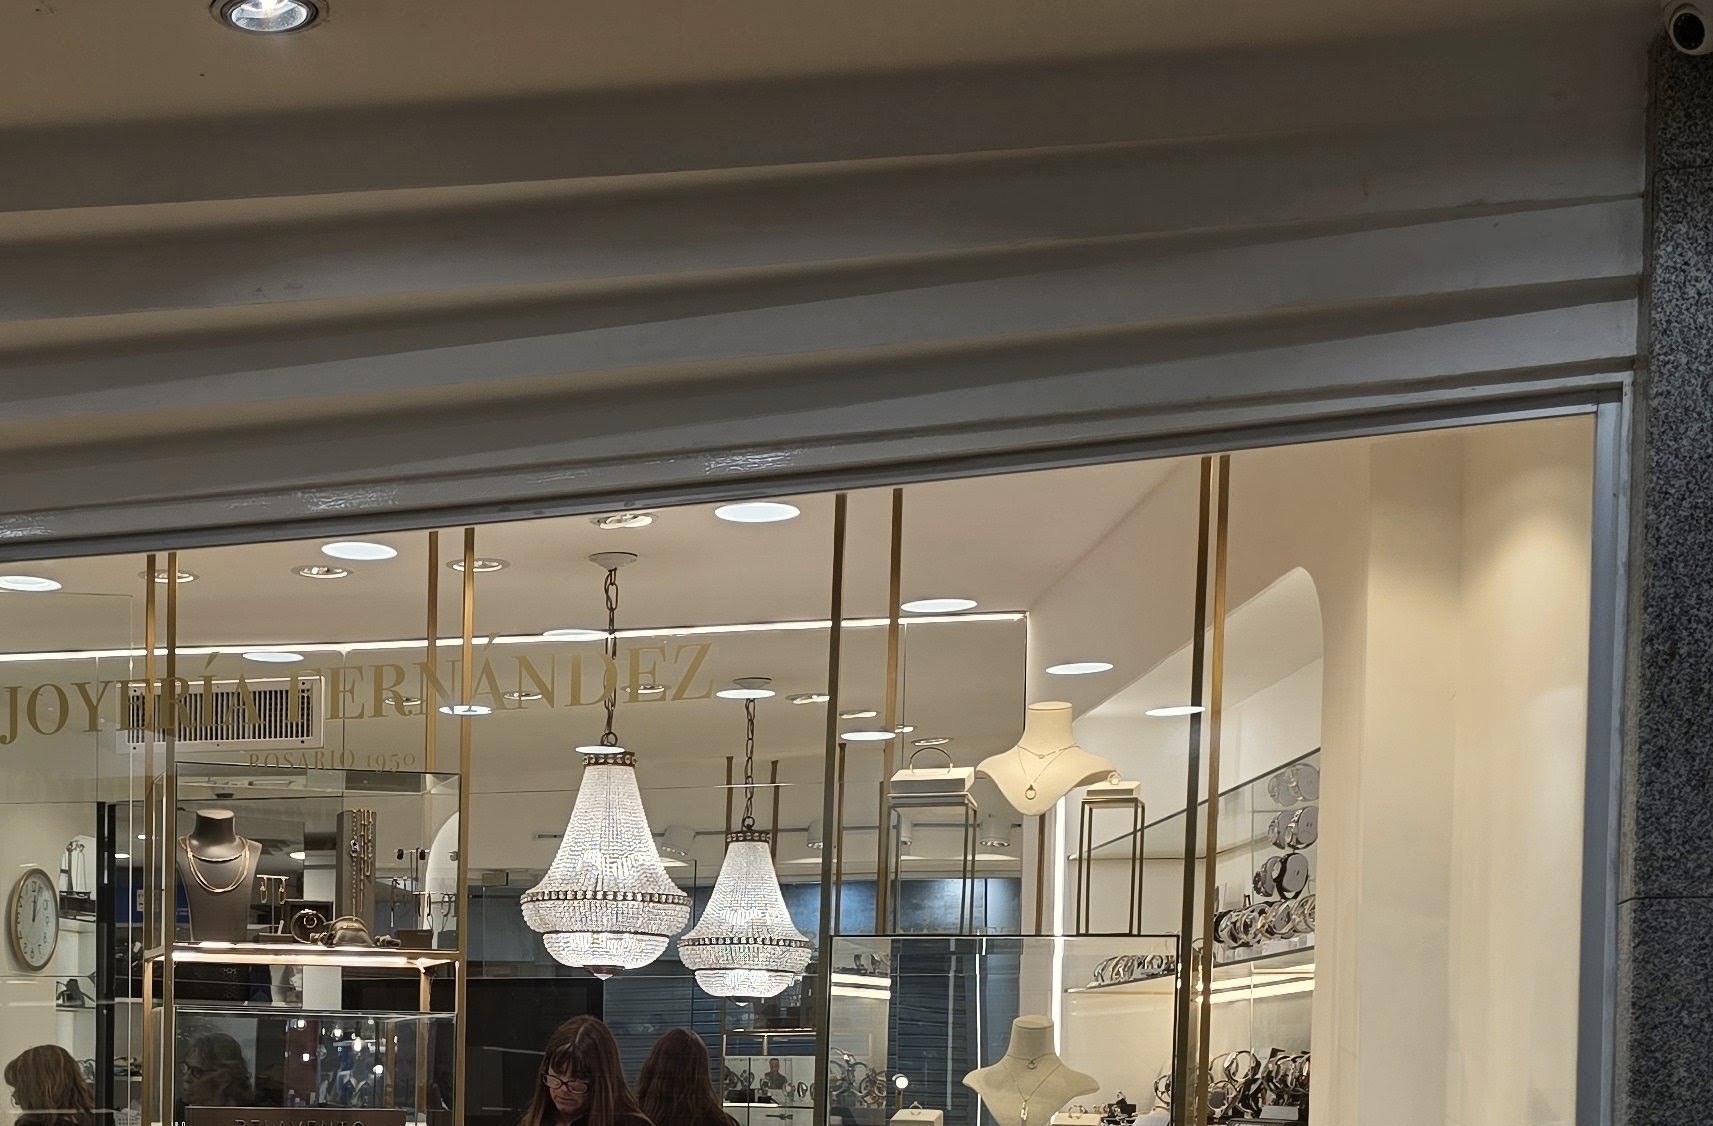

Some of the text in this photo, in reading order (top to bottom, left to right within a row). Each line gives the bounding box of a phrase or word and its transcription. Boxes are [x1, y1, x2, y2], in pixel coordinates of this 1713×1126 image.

[0, 632, 713, 744] JOYERÍA FERNÁNDEZ
[248, 750, 416, 773] ROSARIO 1950
